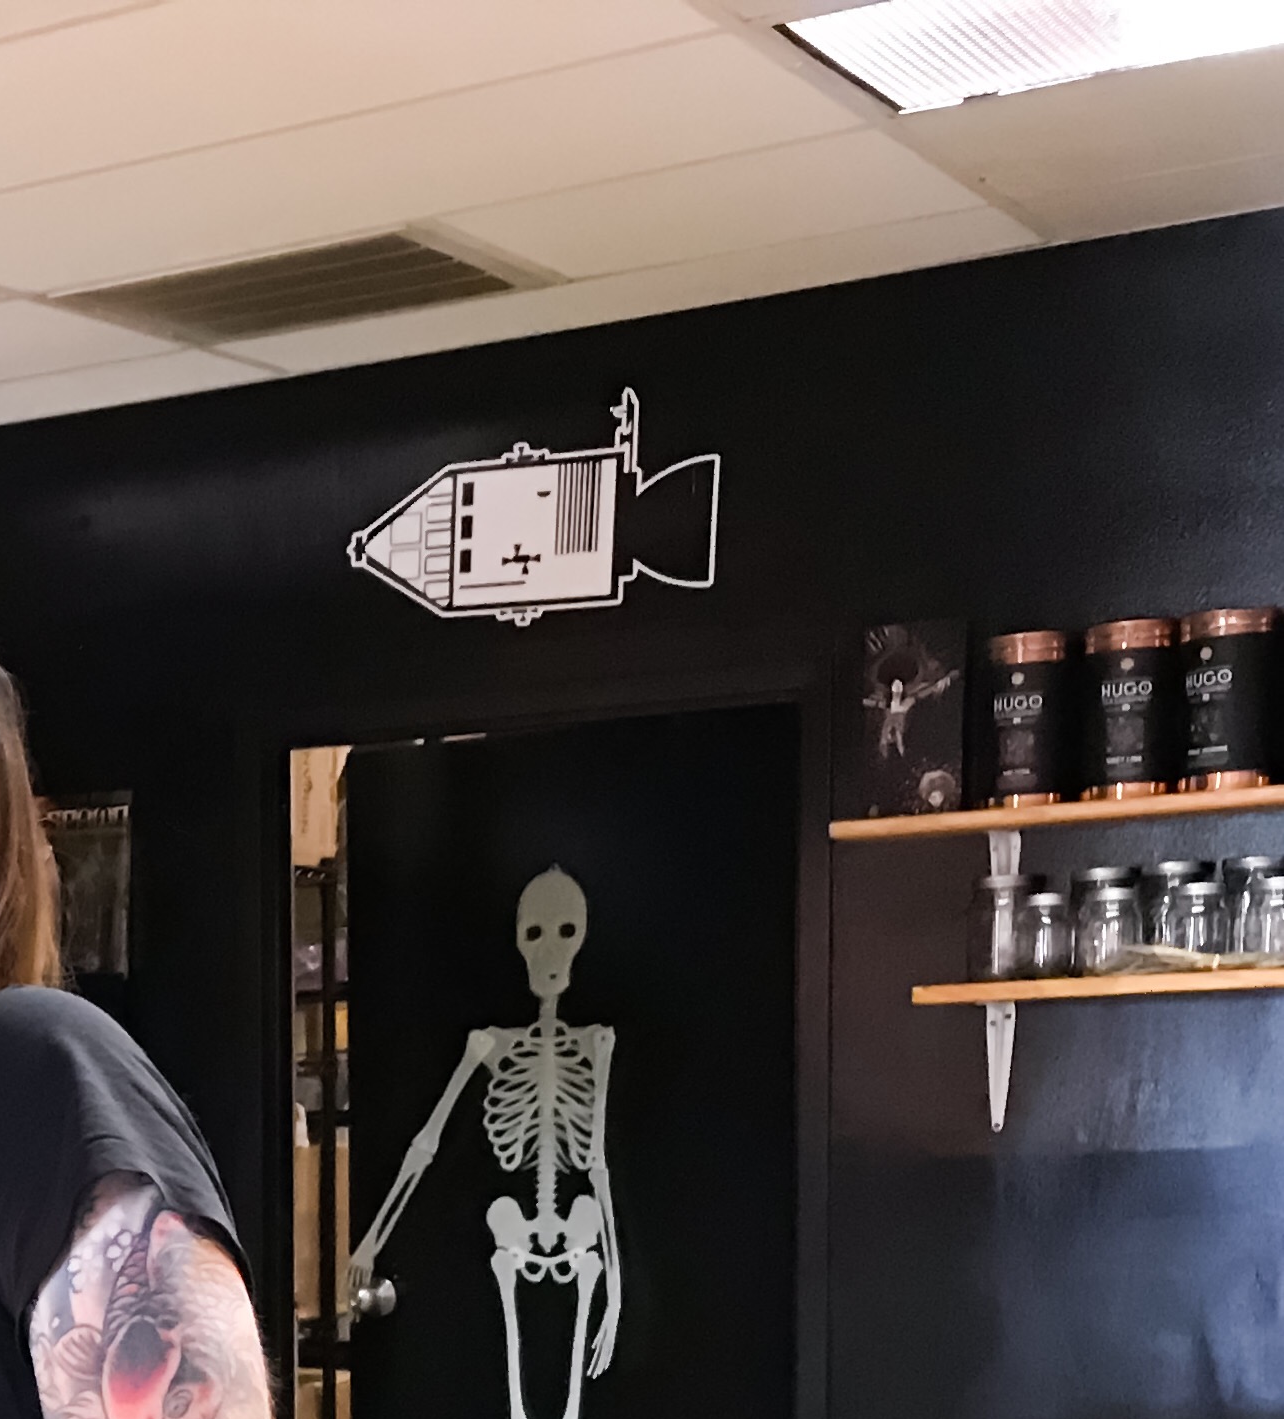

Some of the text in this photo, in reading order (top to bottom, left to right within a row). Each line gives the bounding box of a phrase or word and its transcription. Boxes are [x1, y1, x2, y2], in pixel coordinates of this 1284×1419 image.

[1185, 667, 1232, 689] HUGO
[1101, 680, 1153, 699] HUGO
[994, 694, 1043, 713] HUGO
